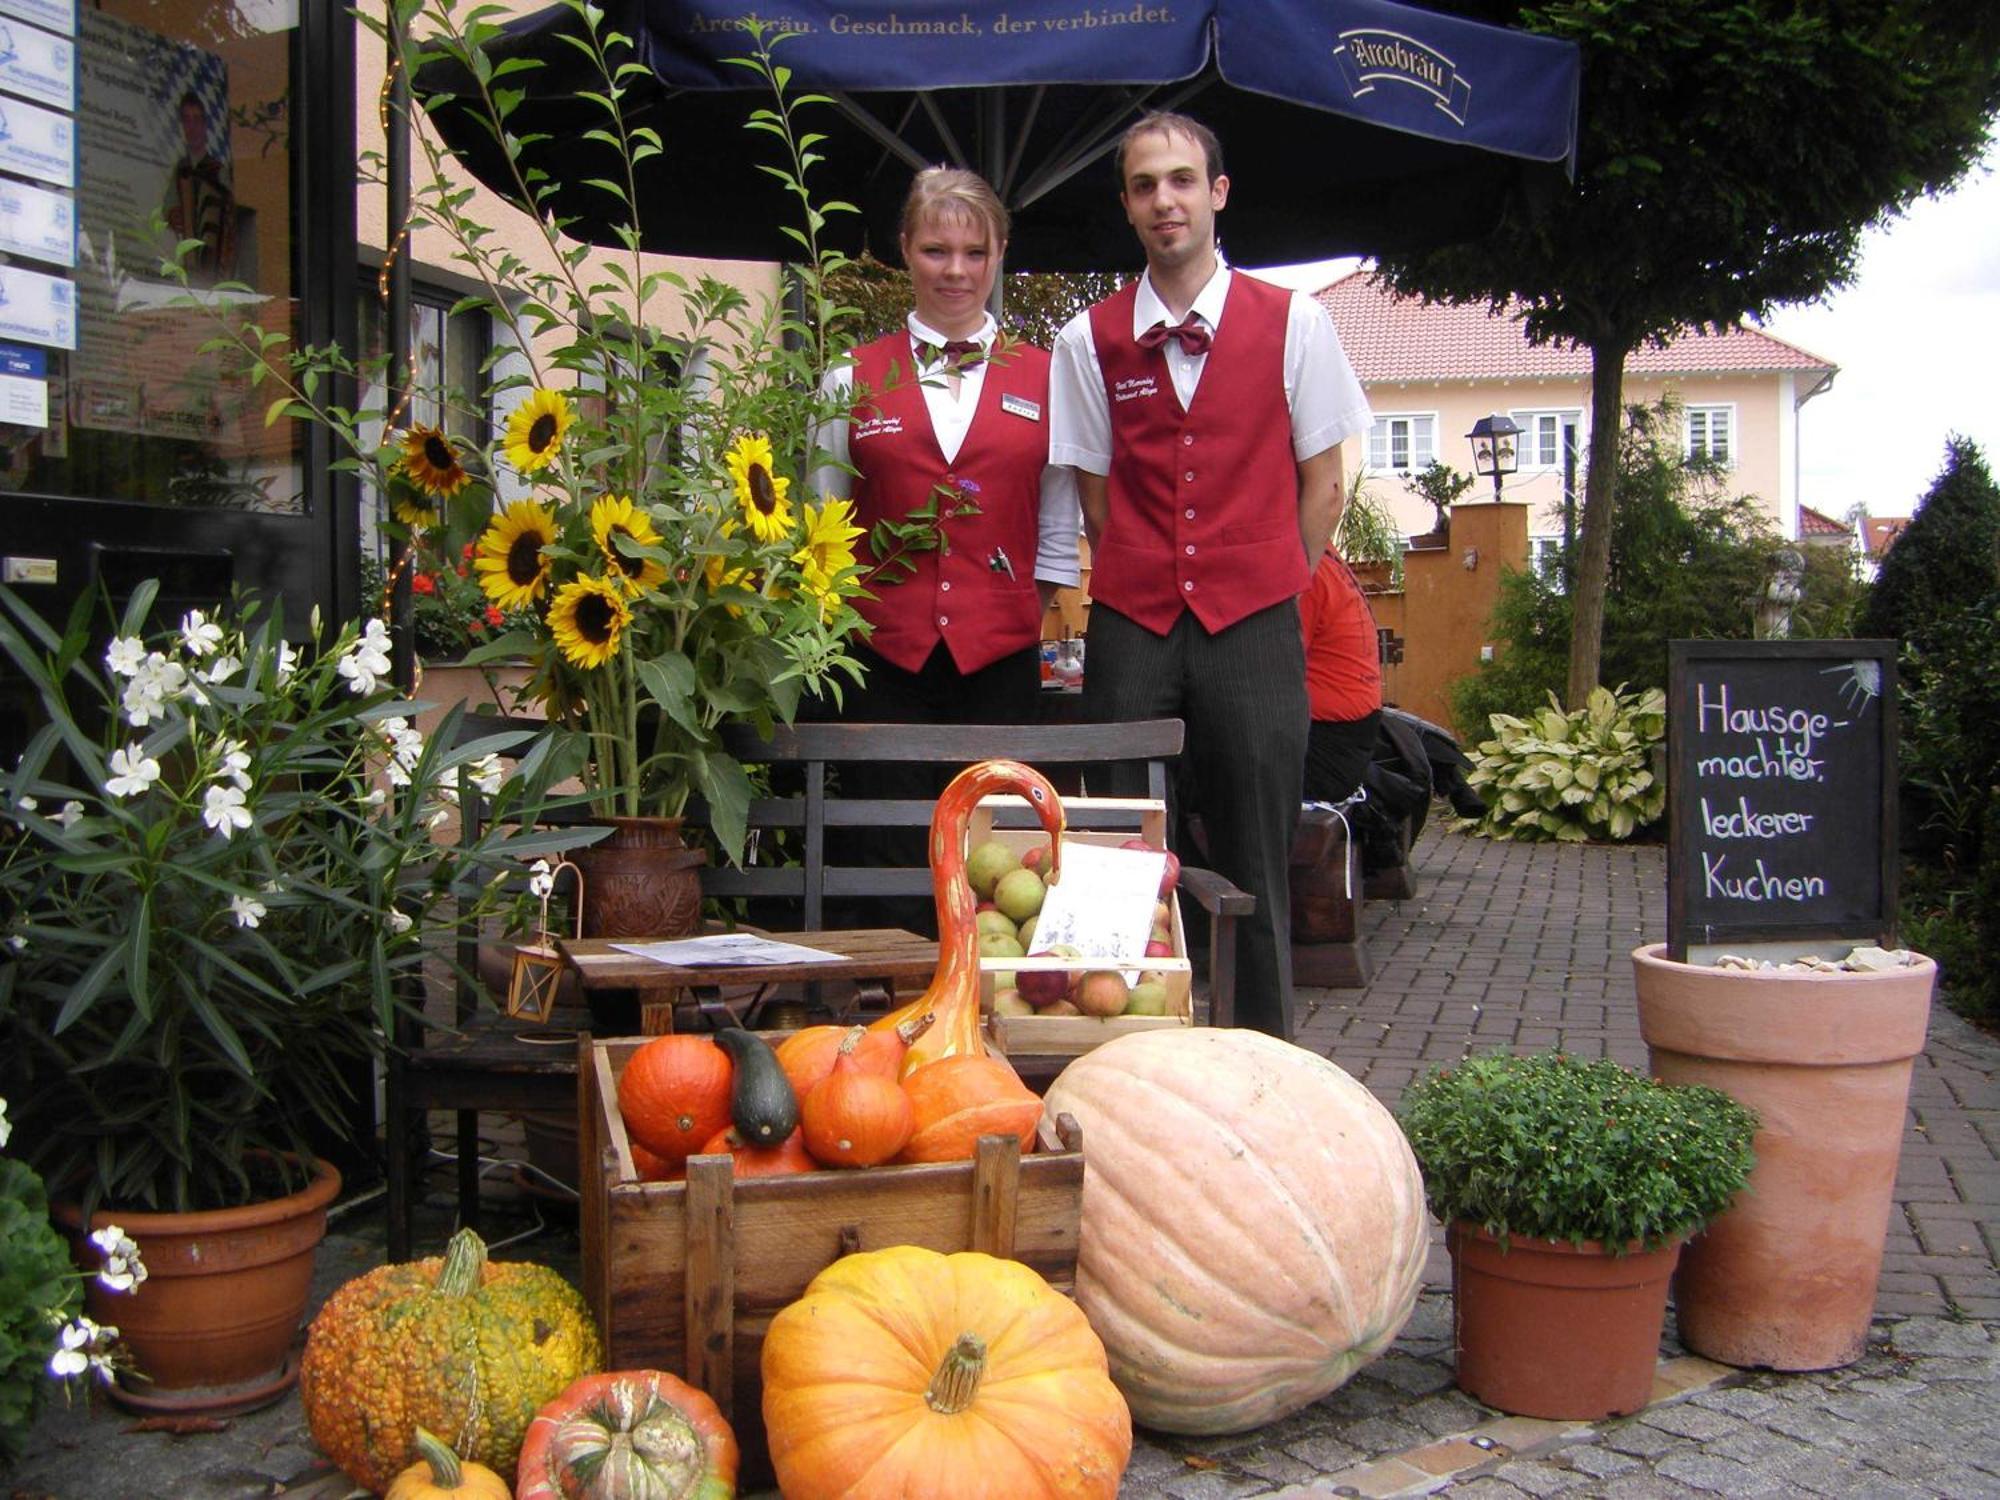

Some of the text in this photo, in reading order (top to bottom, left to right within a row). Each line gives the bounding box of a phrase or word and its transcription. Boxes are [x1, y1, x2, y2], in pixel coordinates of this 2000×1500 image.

[830, 13, 982, 37] Geschmack,
[993, 14, 1036, 34] der
[1043, 4, 1176, 31] verbindet.
[1351, 38, 1443, 87] Arcobräu
[1697, 684, 1849, 756] Hausge-
[1701, 797, 1814, 839] leckerer
[1702, 852, 1825, 902] Kuchen
